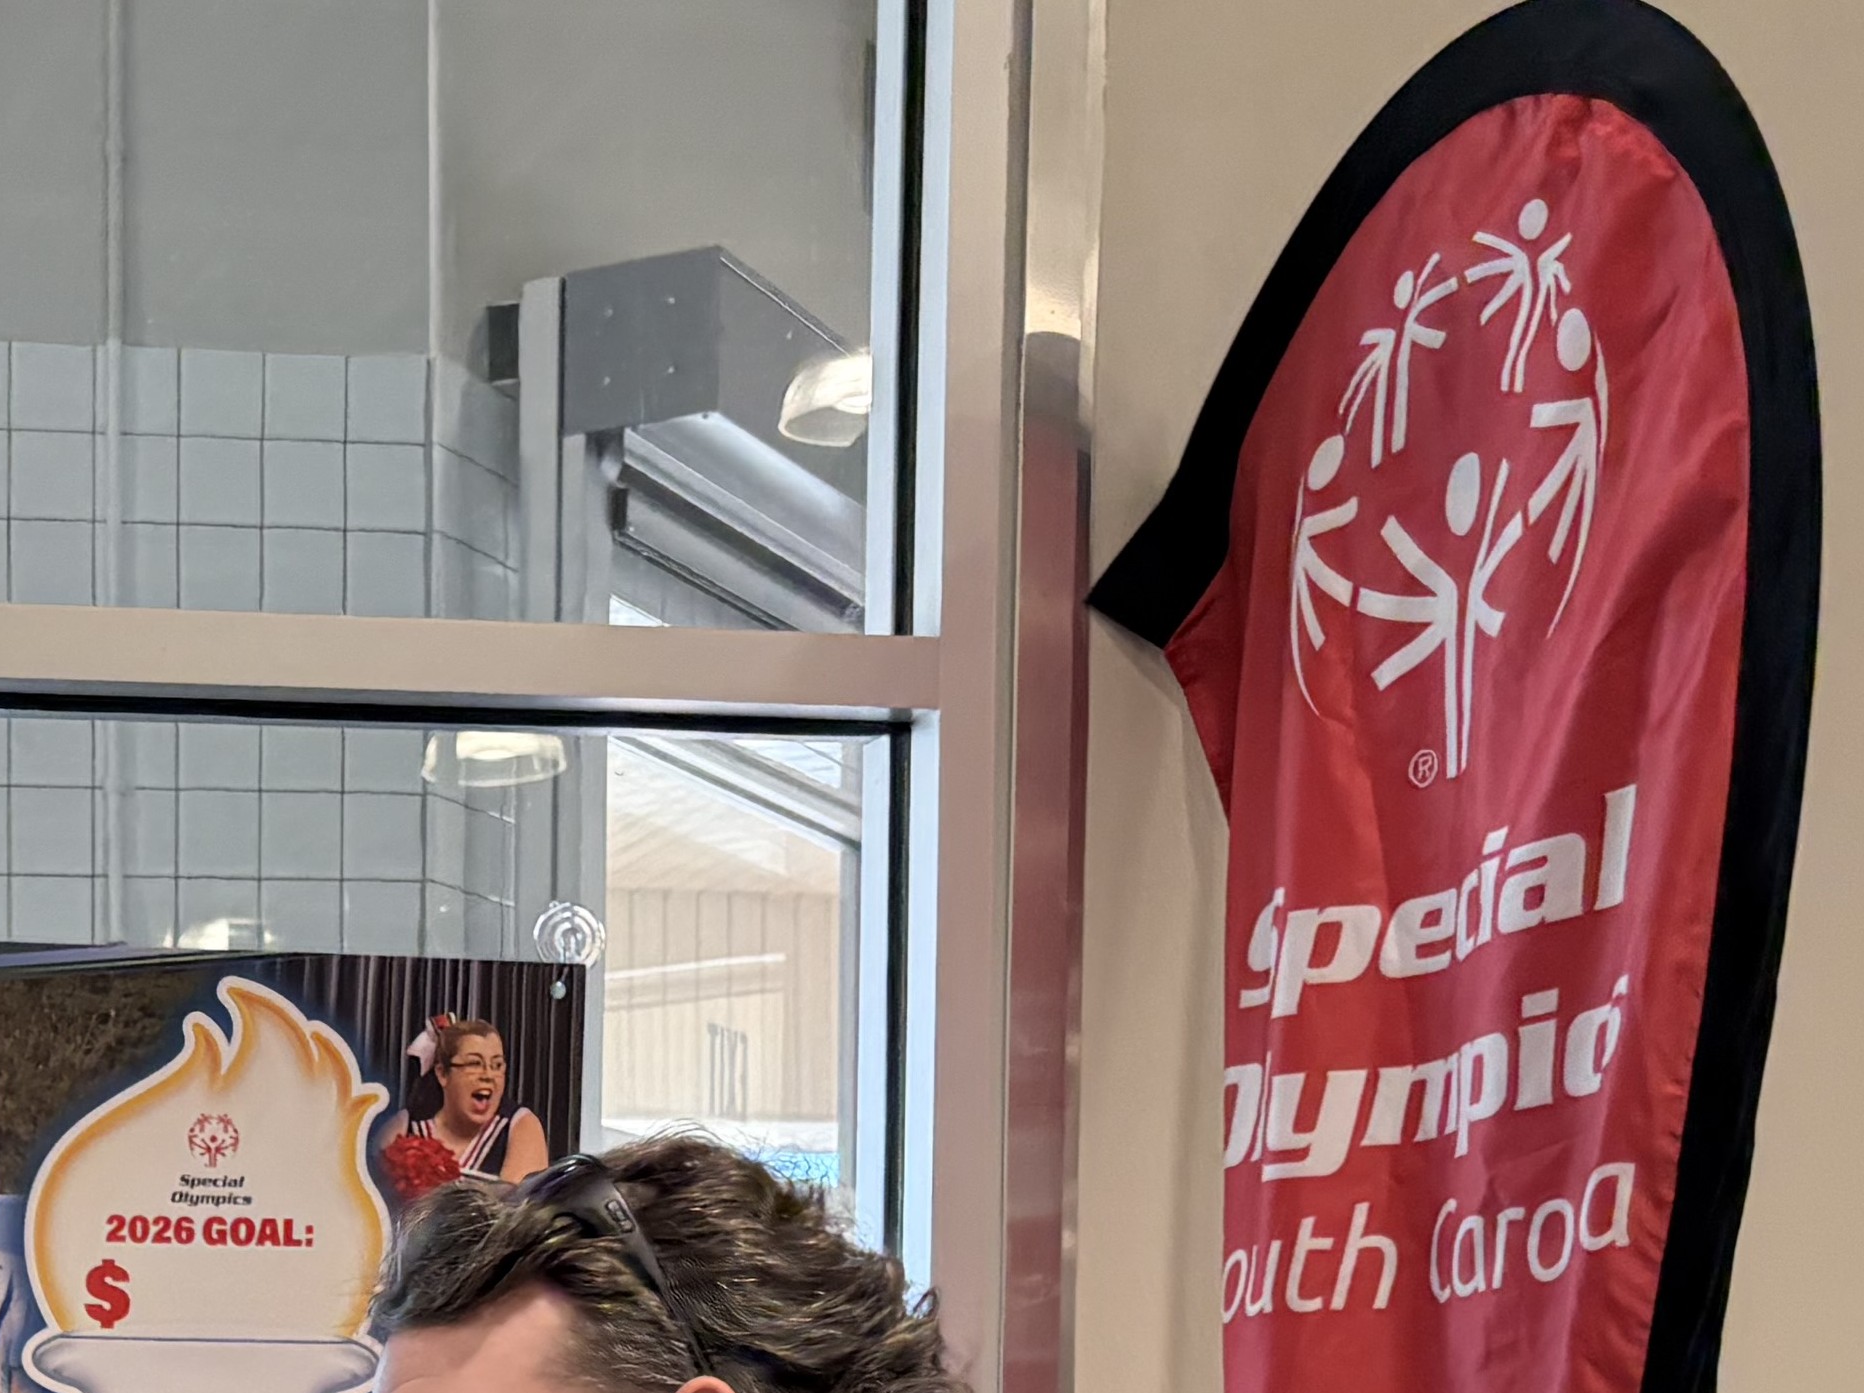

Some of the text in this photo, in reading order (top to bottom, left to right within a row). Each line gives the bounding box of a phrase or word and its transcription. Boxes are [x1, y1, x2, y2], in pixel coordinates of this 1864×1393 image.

[179, 1174, 245, 1189] Special
[170, 1191, 253, 1207] Olympics
[106, 1214, 314, 1247] 2026 GOAL:
[1220, 1202, 1399, 1323] outh
[84, 1259, 131, 1329] $
